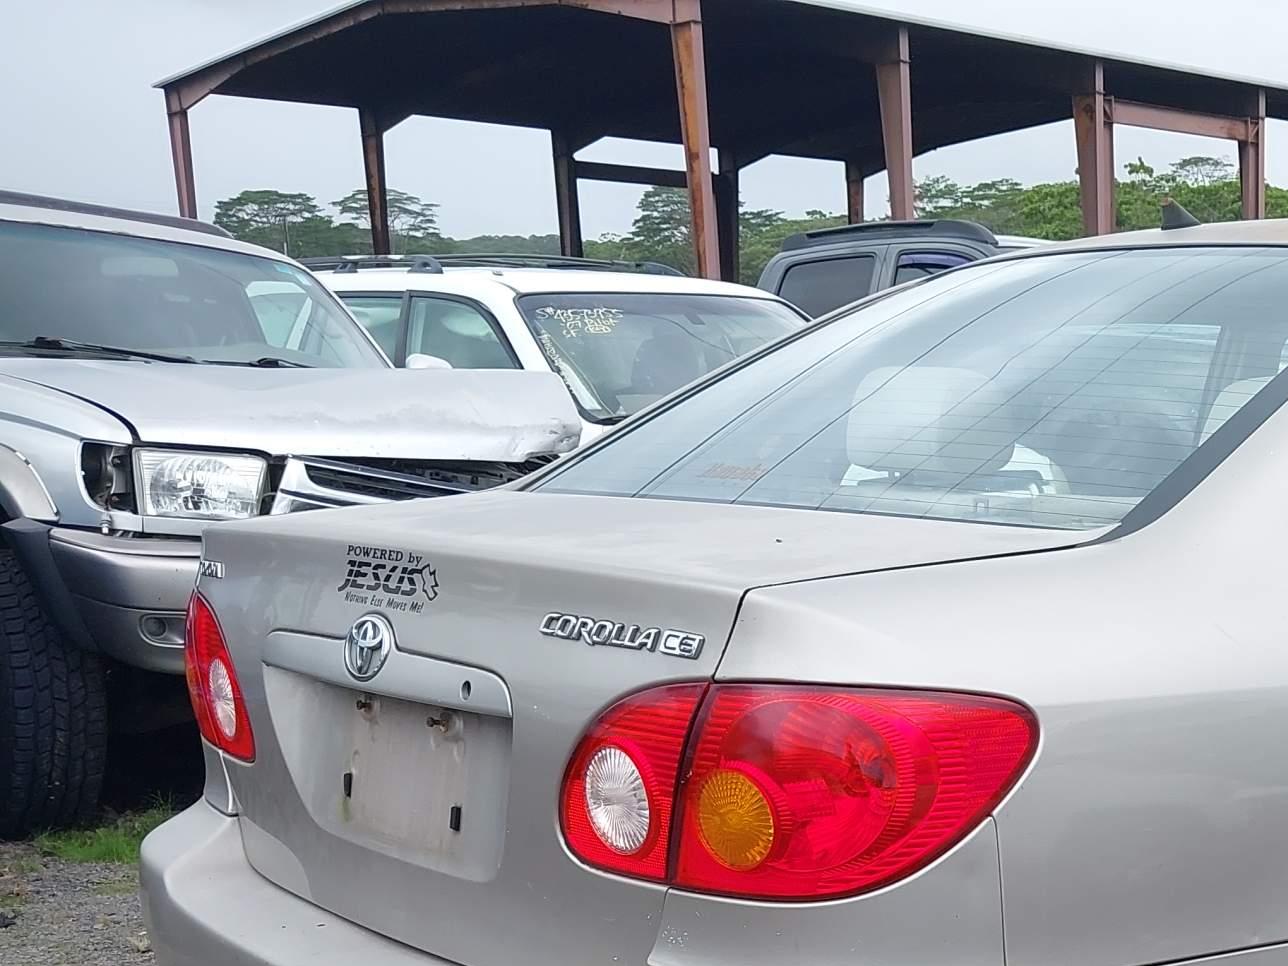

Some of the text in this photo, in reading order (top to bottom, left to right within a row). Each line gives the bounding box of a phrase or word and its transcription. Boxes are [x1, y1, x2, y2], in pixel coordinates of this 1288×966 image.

[347, 545, 423, 566] POWERED by
[338, 560, 422, 596] JESUS
[539, 611, 701, 658] COROLLA CE
